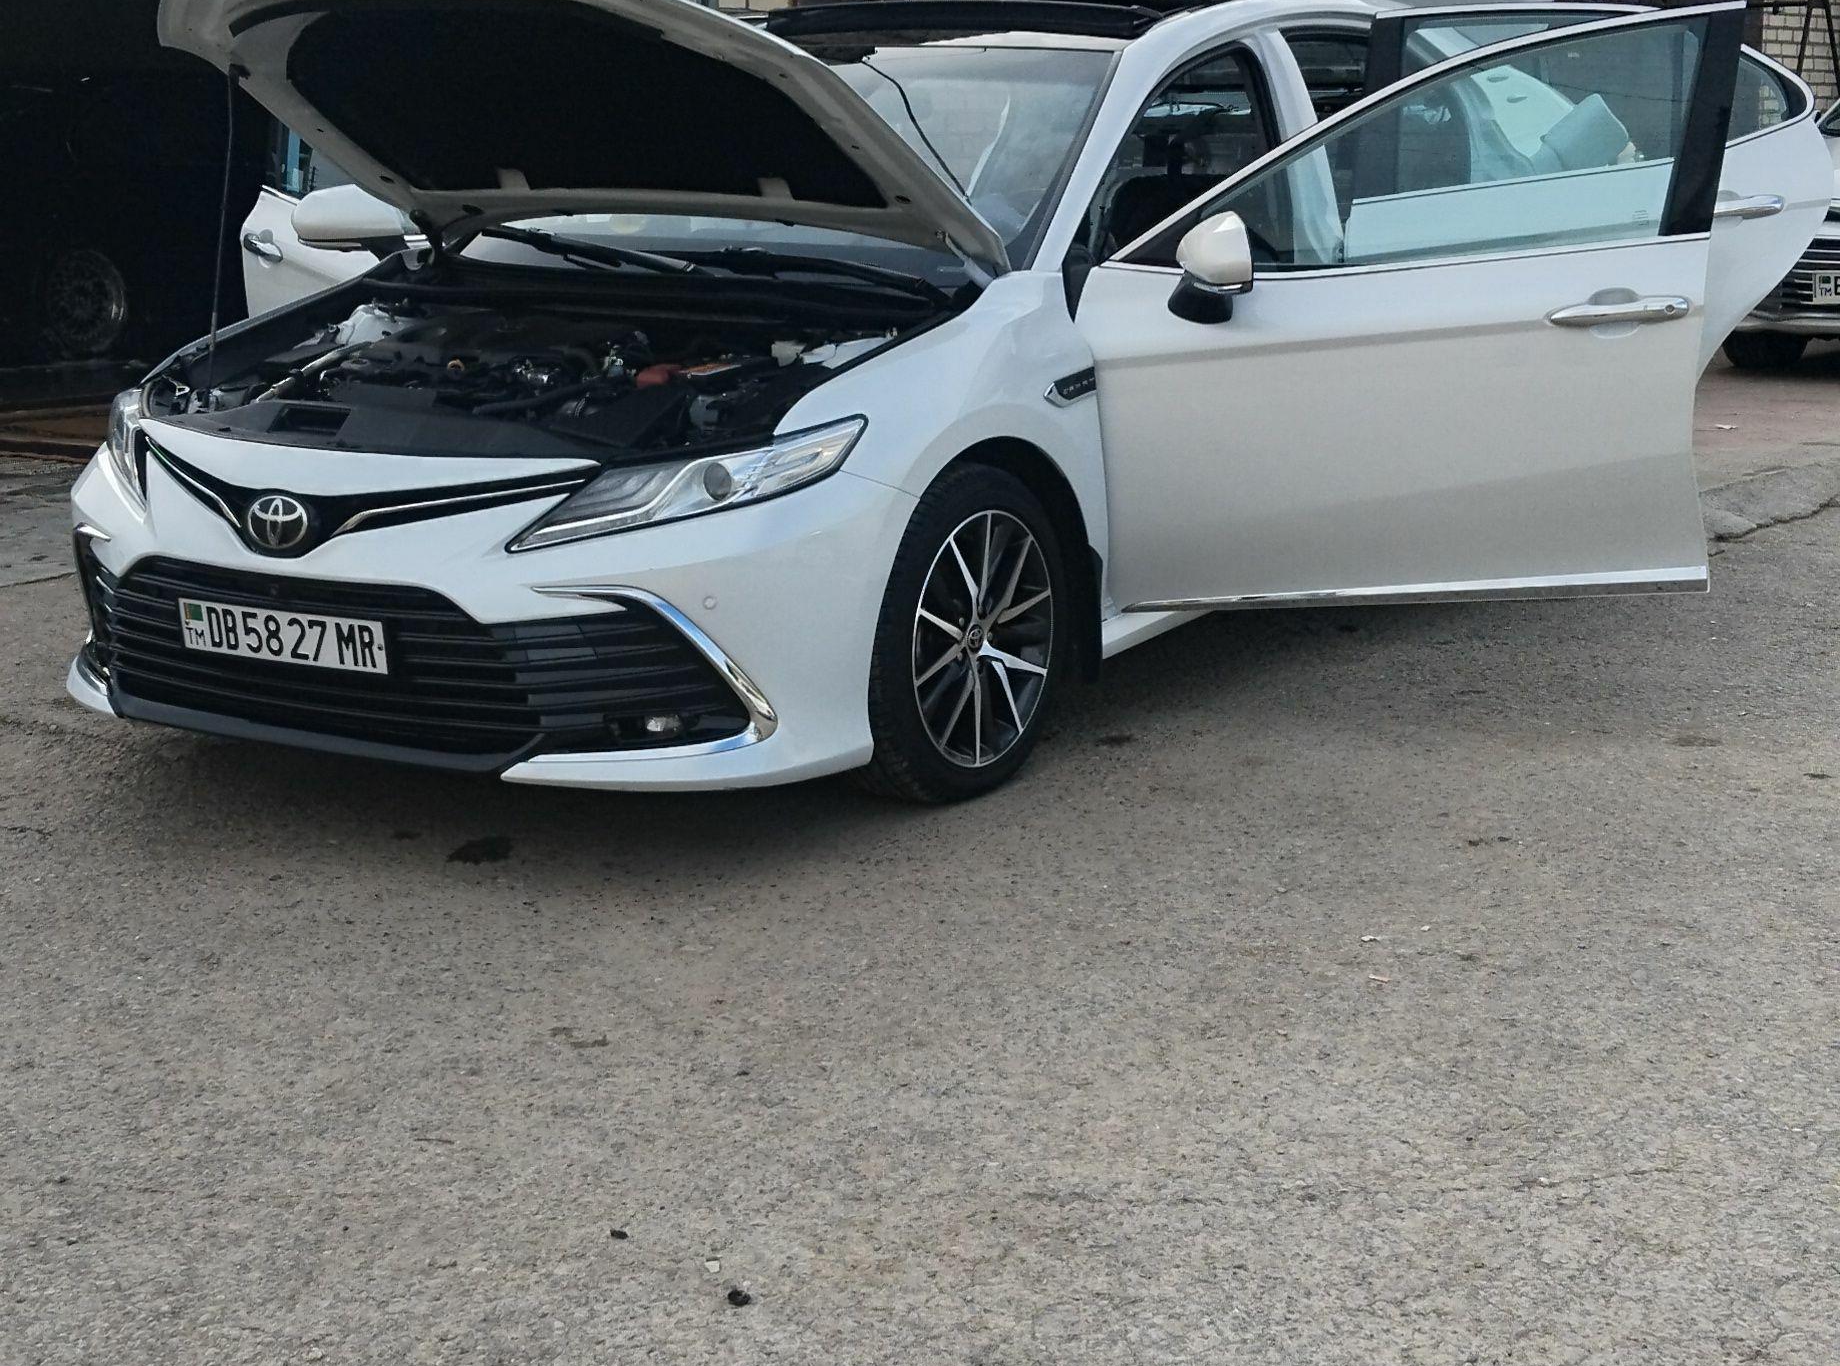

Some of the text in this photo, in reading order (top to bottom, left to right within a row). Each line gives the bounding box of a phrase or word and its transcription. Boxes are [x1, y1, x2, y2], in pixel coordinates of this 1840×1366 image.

[1819, 287, 1832, 297] TM
[185, 626, 207, 647] TM
[335, 622, 377, 669] MR
